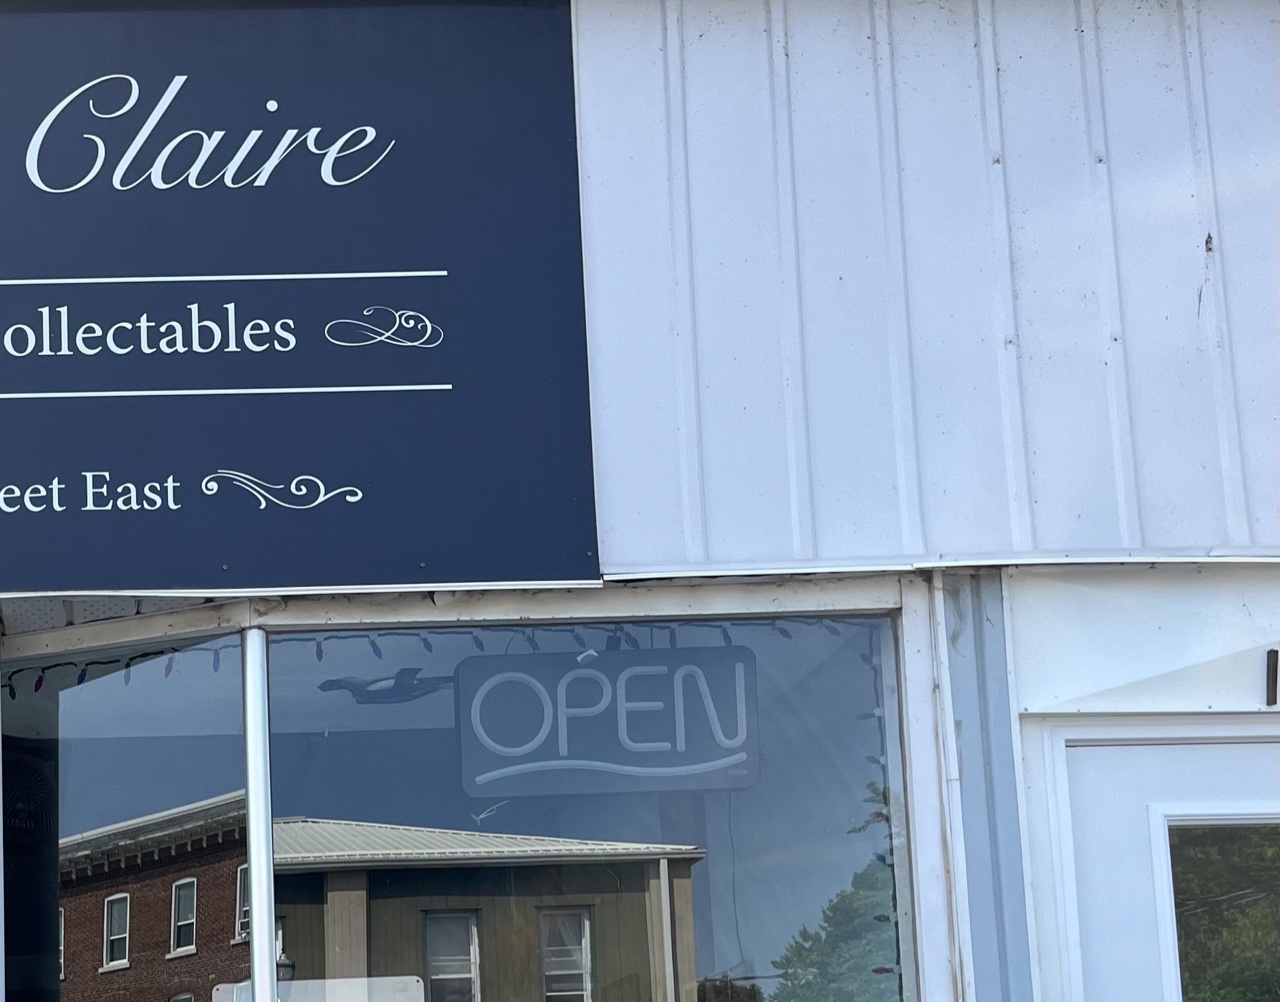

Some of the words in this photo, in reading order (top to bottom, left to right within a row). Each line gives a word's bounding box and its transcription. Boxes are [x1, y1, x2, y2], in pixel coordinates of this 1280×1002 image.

[26, 75, 396, 192] Claire
[82, 472, 182, 511] East
[471, 662, 747, 757] OPEN
